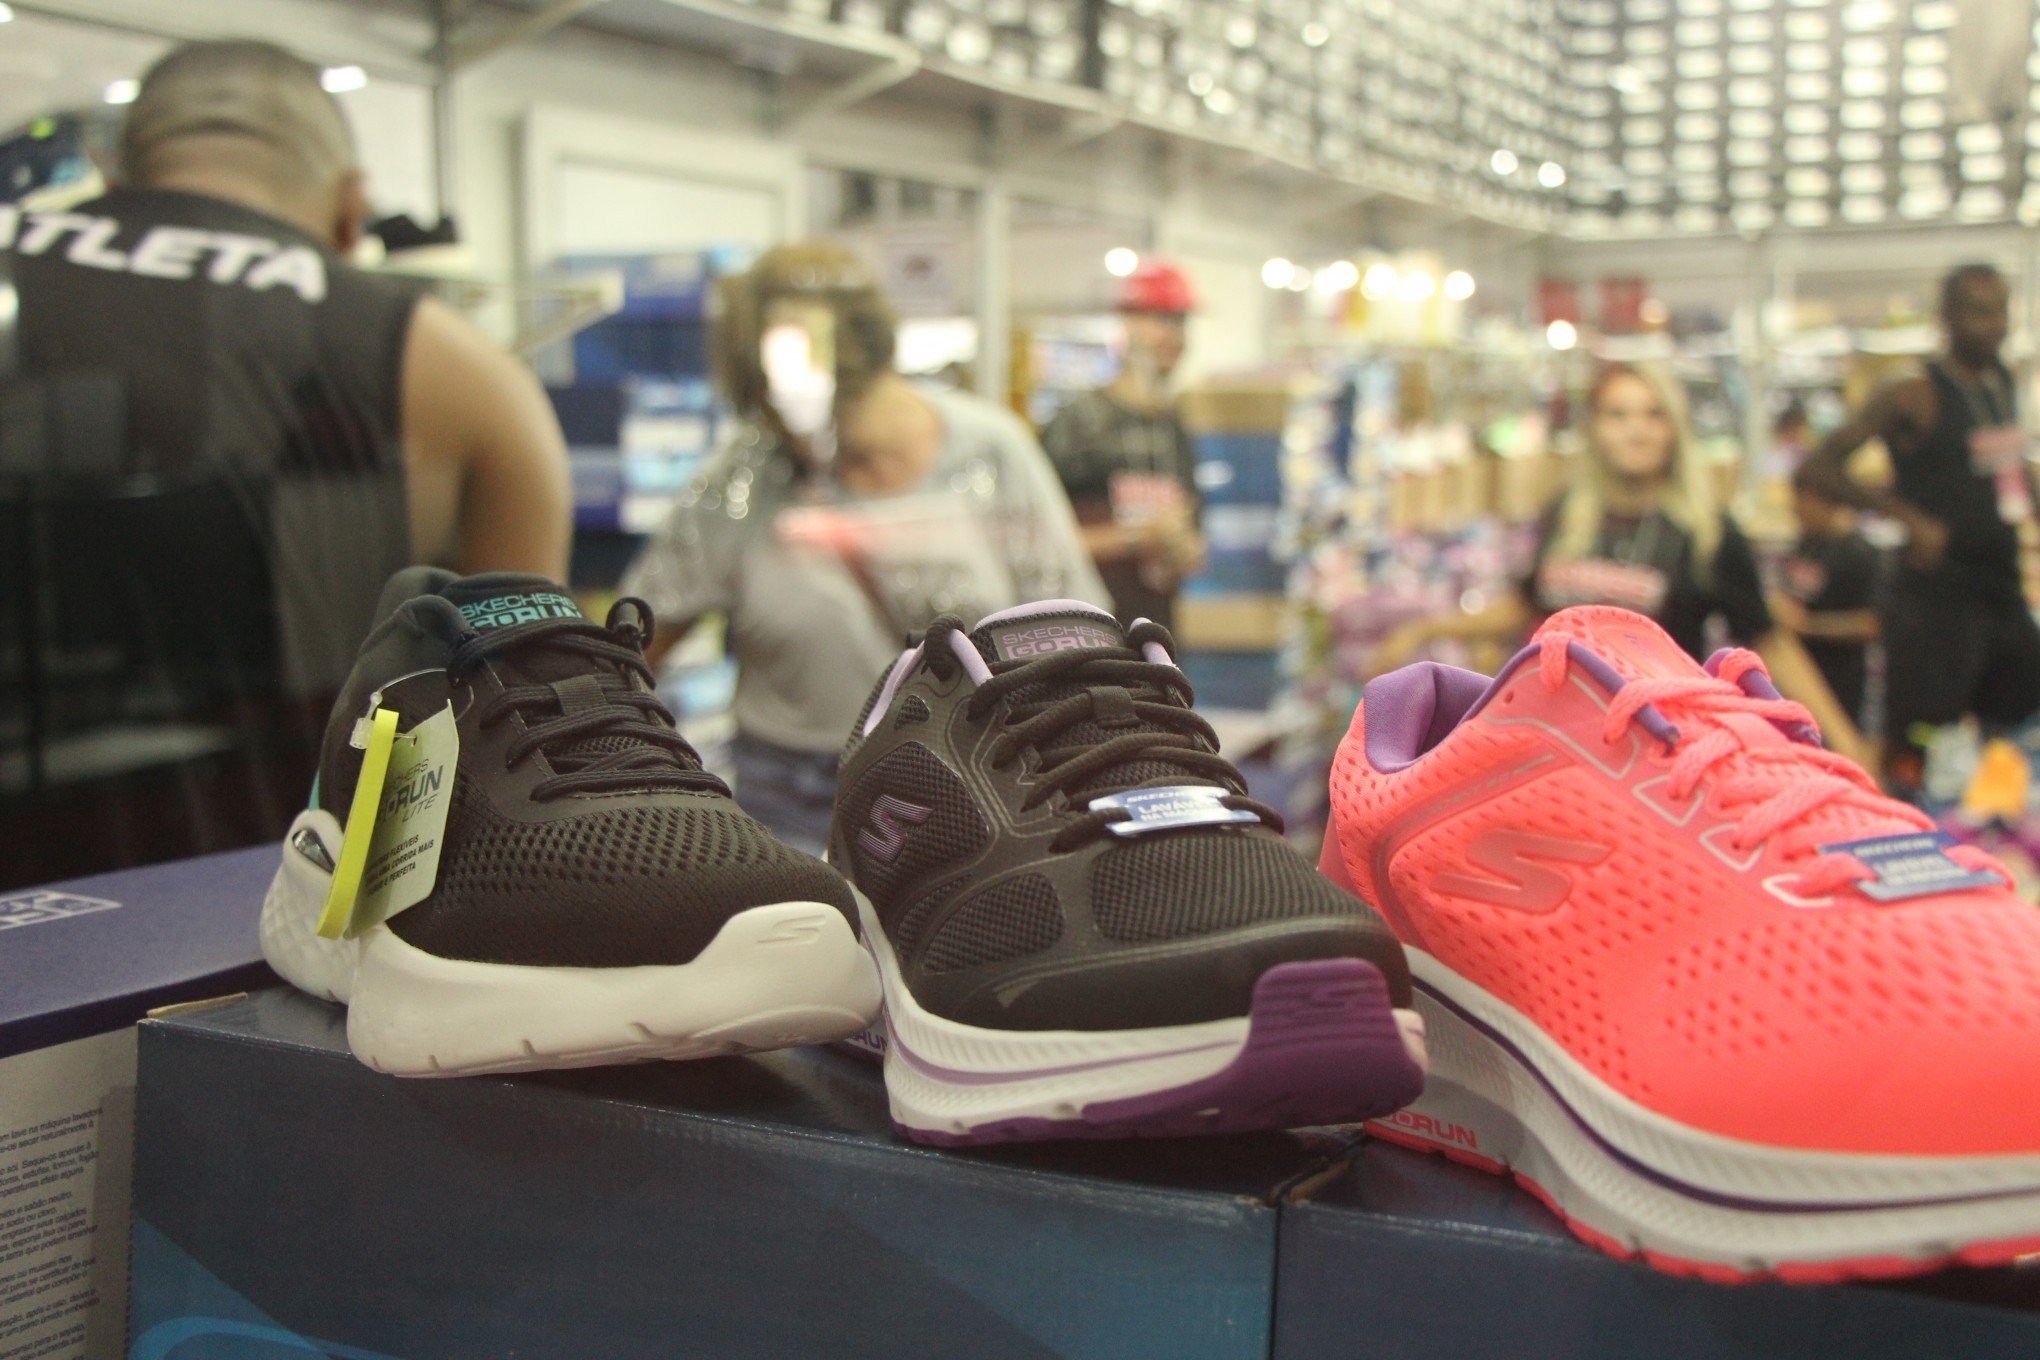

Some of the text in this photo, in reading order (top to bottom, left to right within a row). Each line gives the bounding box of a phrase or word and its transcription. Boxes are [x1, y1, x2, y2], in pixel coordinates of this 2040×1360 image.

[461, 592, 577, 620] SKECHERS
[1002, 626, 1119, 645] SKECHERS
[402, 793, 439, 823] LITE
[418, 839, 435, 855] MAIS
